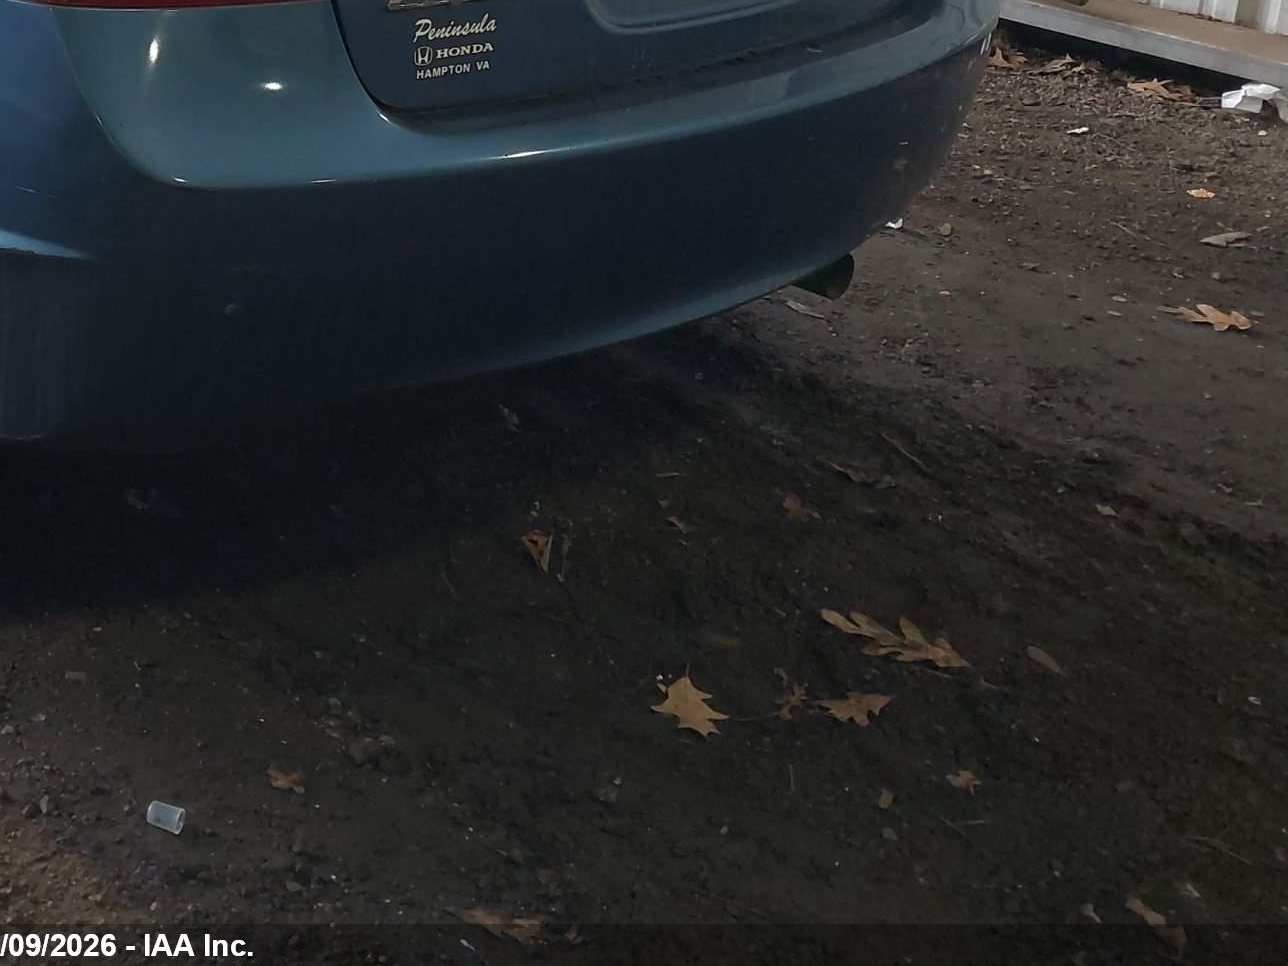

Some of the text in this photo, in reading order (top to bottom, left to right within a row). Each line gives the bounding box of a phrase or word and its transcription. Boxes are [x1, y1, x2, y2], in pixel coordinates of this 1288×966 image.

[413, 13, 497, 43] Peninsula
[435, 42, 494, 59] HONDA
[416, 60, 490, 80] HAMPTON VA
